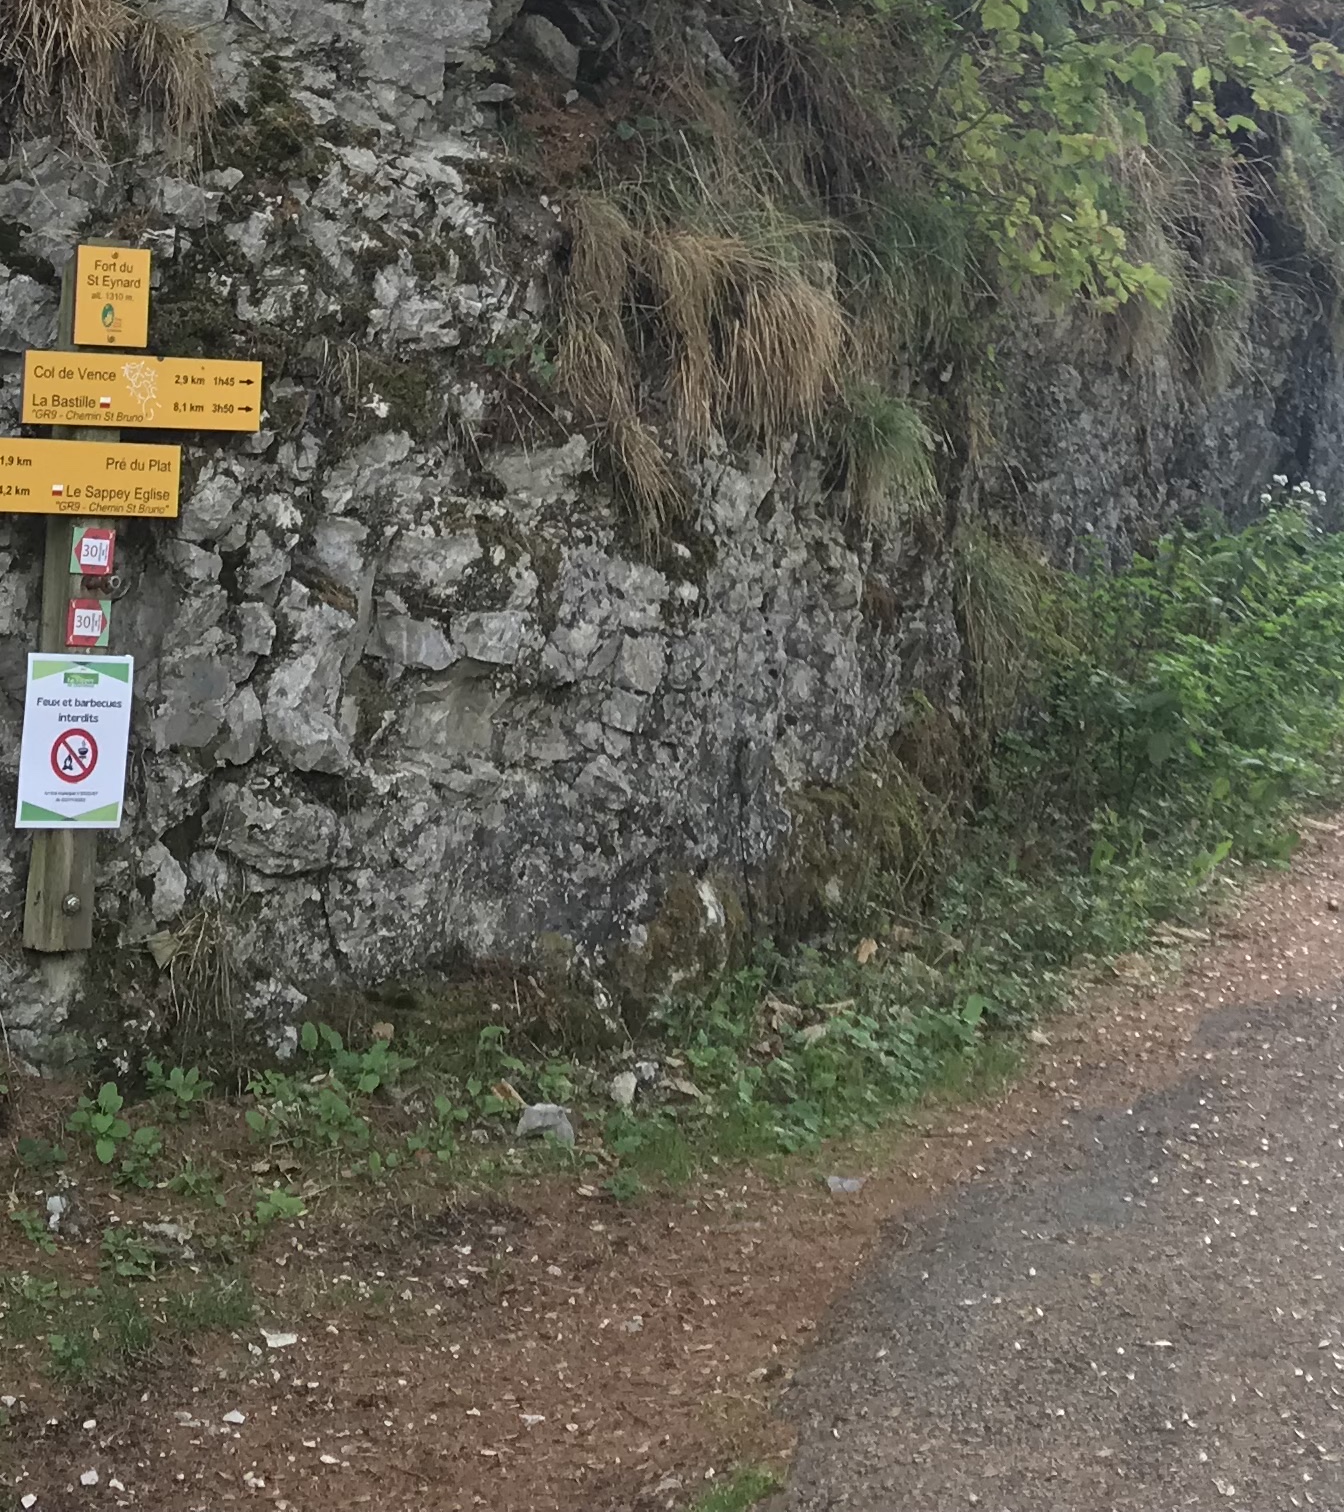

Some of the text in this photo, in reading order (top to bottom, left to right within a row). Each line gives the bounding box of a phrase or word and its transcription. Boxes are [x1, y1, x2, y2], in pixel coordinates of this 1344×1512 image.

[95, 260, 133, 273] Fort du
[87, 274, 141, 289] St Eynard
[106, 292, 123, 301] 1310
[34, 365, 116, 382] Col de Vence
[174, 375, 235, 387] 2,9 km 1h45
[32, 394, 96, 408] La Bastille
[174, 402, 234, 414] 8,1 km 3h50
[66, 410, 102, 421] Chemin
[105, 412, 114, 421] St
[0, 456, 14, 466] 1,9
[16, 456, 32, 466] km
[106, 458, 171, 472] Pré du Plat
[15, 486, 30, 496] km
[66, 486, 170, 503] Le Sappey Eglise
[89, 502, 123, 513] Chemin
[126, 504, 137, 513] St
[83, 544, 98, 557] 30
[76, 615, 90, 628] 30
[37, 697, 122, 708] Feux et barbecues
[58, 713, 98, 723] interdits
